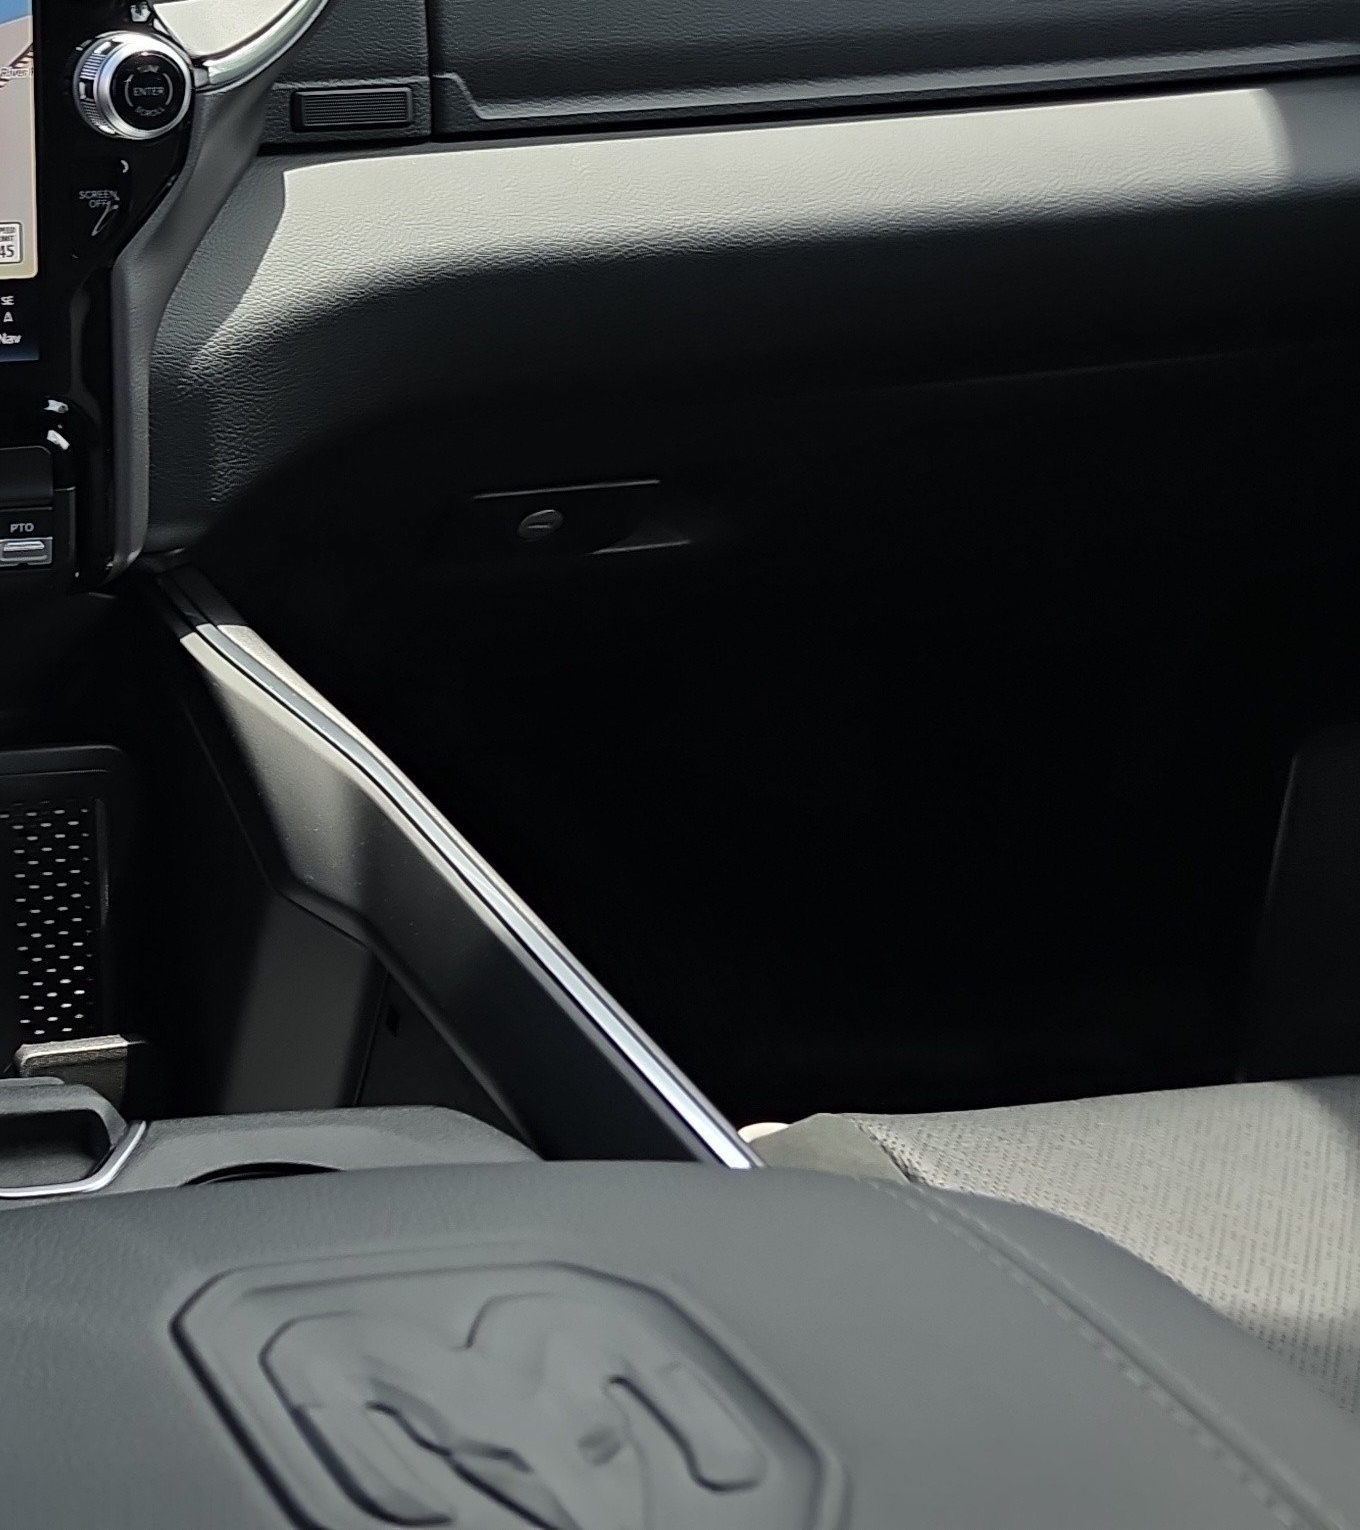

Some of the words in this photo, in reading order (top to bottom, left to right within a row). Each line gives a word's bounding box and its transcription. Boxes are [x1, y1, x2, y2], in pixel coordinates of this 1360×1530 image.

[133, 86, 165, 96] ENTER
[79, 190, 117, 200] SCREEN
[10, 522, 34, 533] PTO
